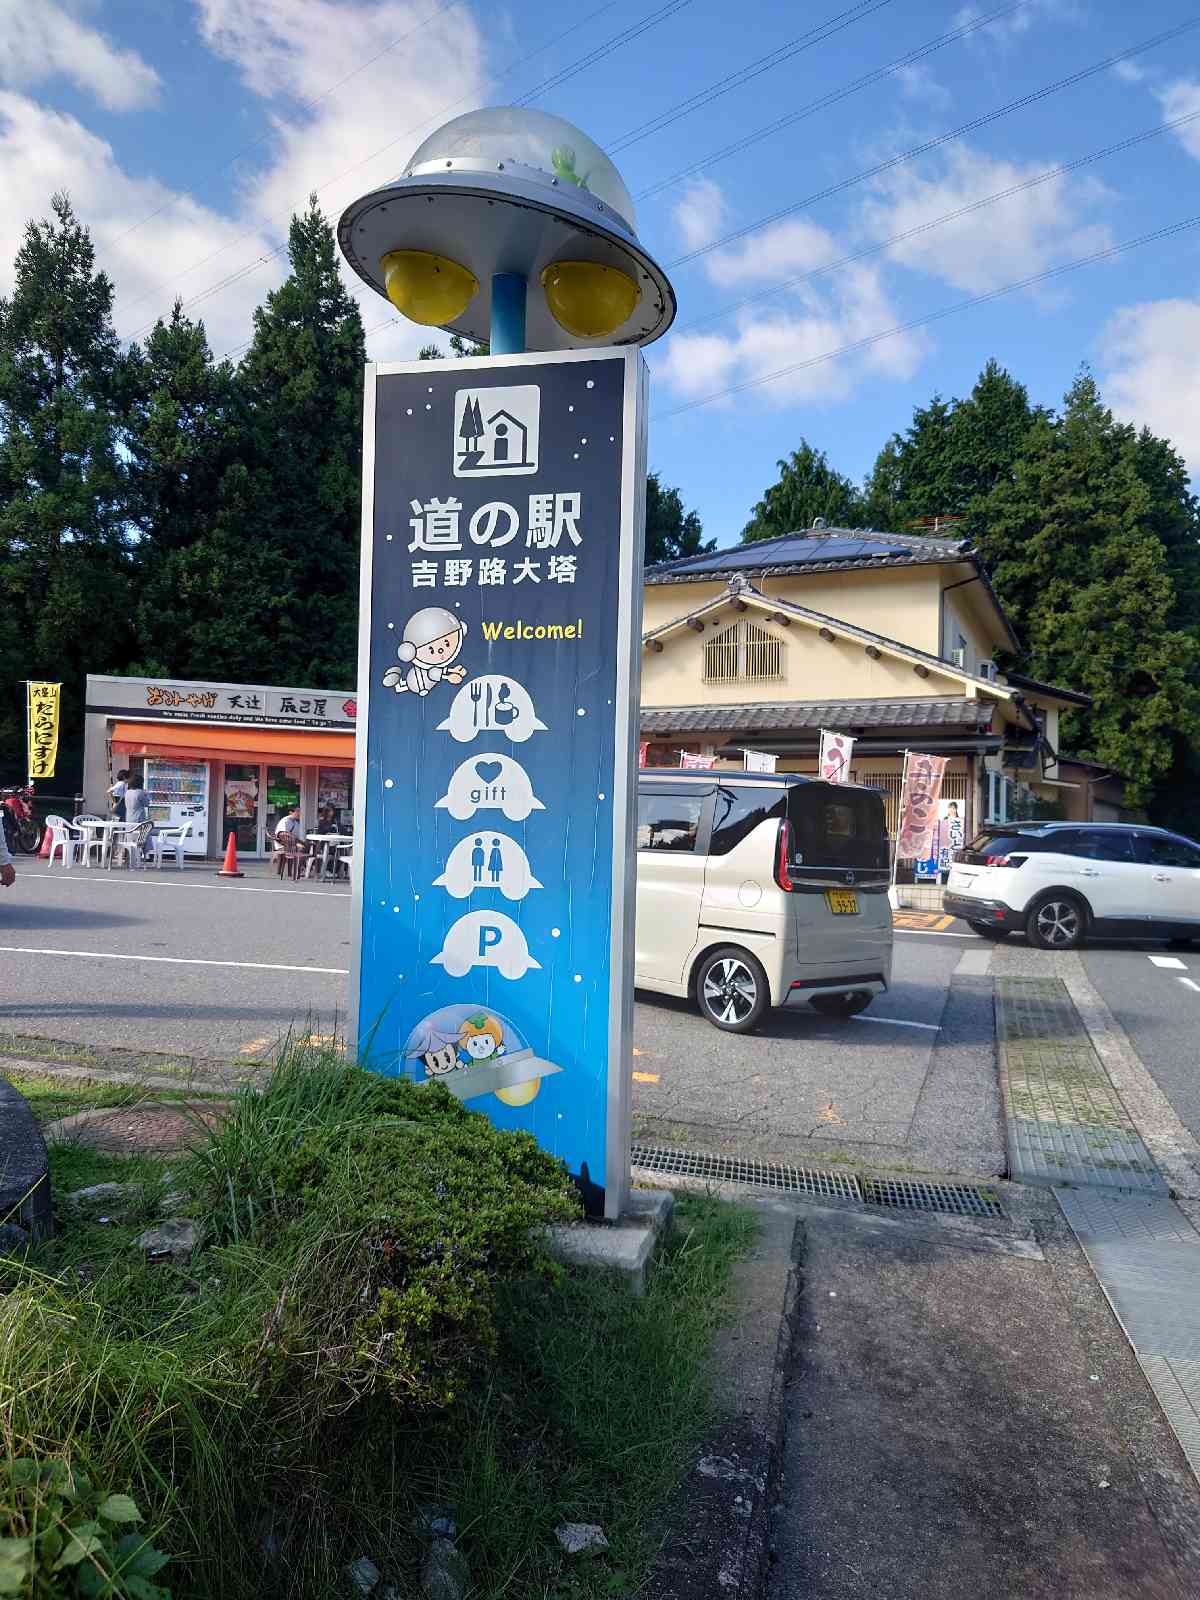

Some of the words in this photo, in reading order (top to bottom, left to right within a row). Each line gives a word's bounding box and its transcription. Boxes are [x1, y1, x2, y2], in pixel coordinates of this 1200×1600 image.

[408, 492, 582, 553] 道の駅
[411, 556, 577, 587] 吉野路大塔
[481, 618, 583, 641] Welcome!
[470, 786, 507, 804] gift
[479, 926, 503, 956] P
